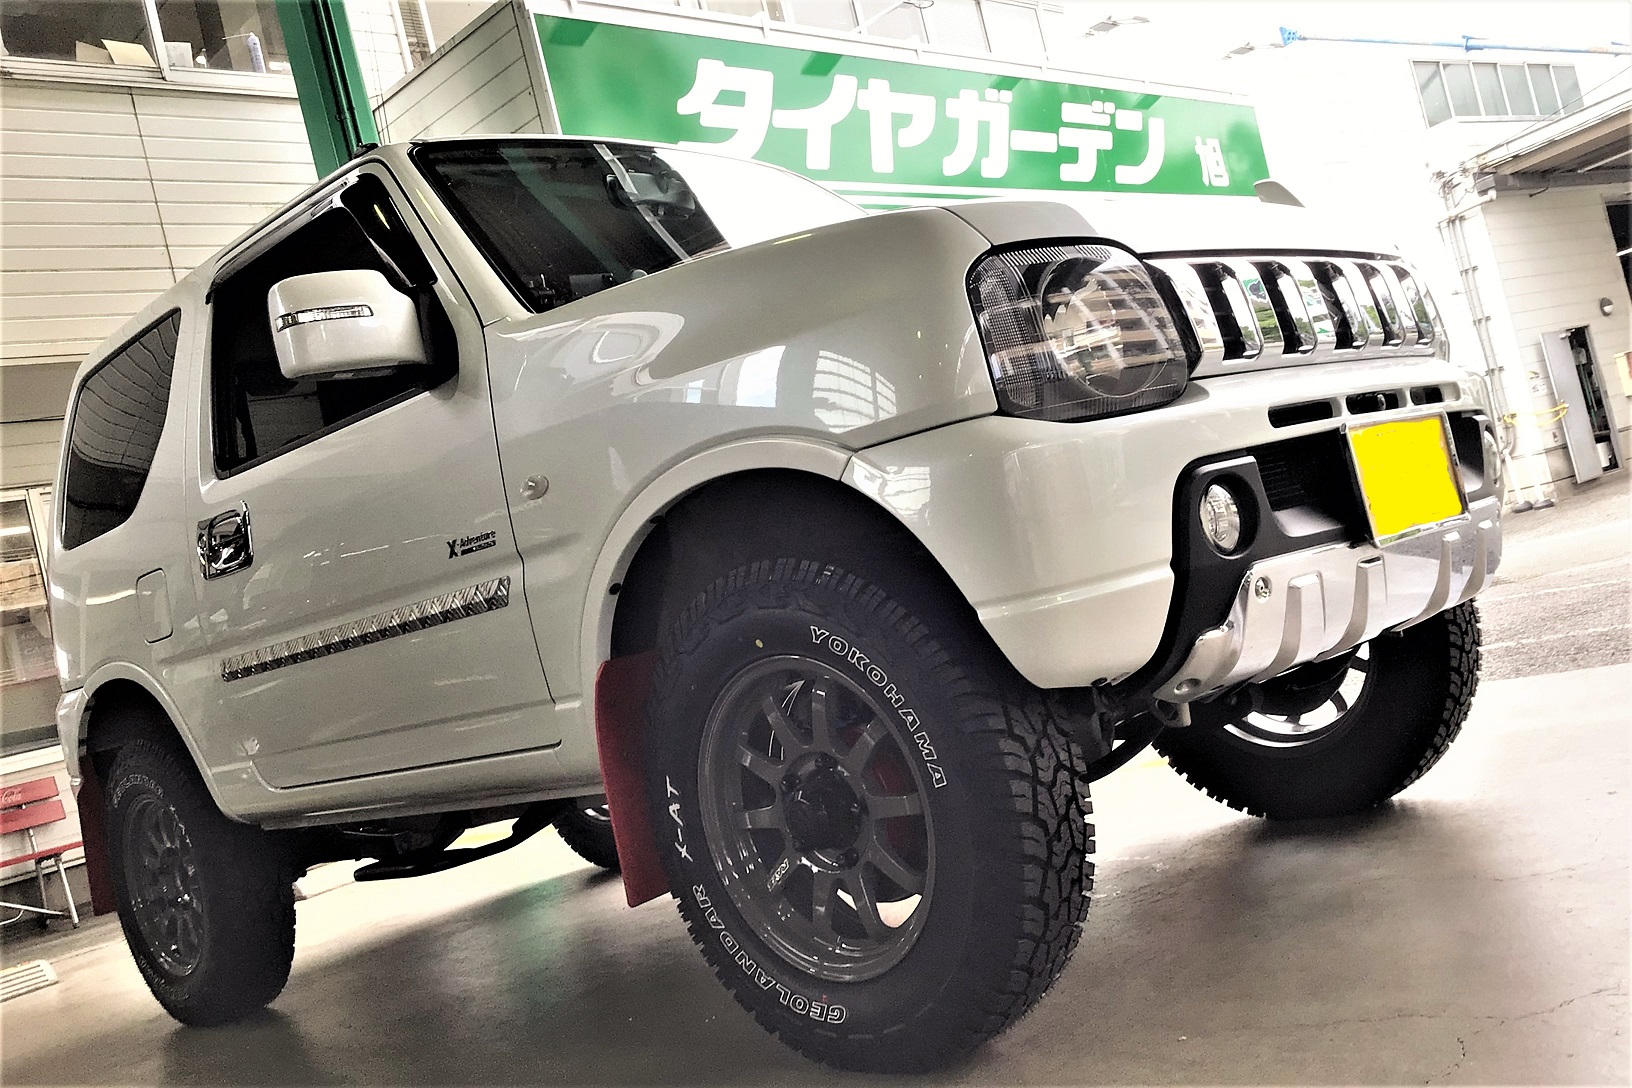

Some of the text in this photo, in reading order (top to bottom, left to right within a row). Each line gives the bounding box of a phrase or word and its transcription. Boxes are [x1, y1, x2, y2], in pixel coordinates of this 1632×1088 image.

[677, 58, 1230, 187] タイヤガーデン 旭
[810, 625, 948, 789] YOKOHAMA
[665, 775, 847, 1024] GEOLANDAR X-AT
